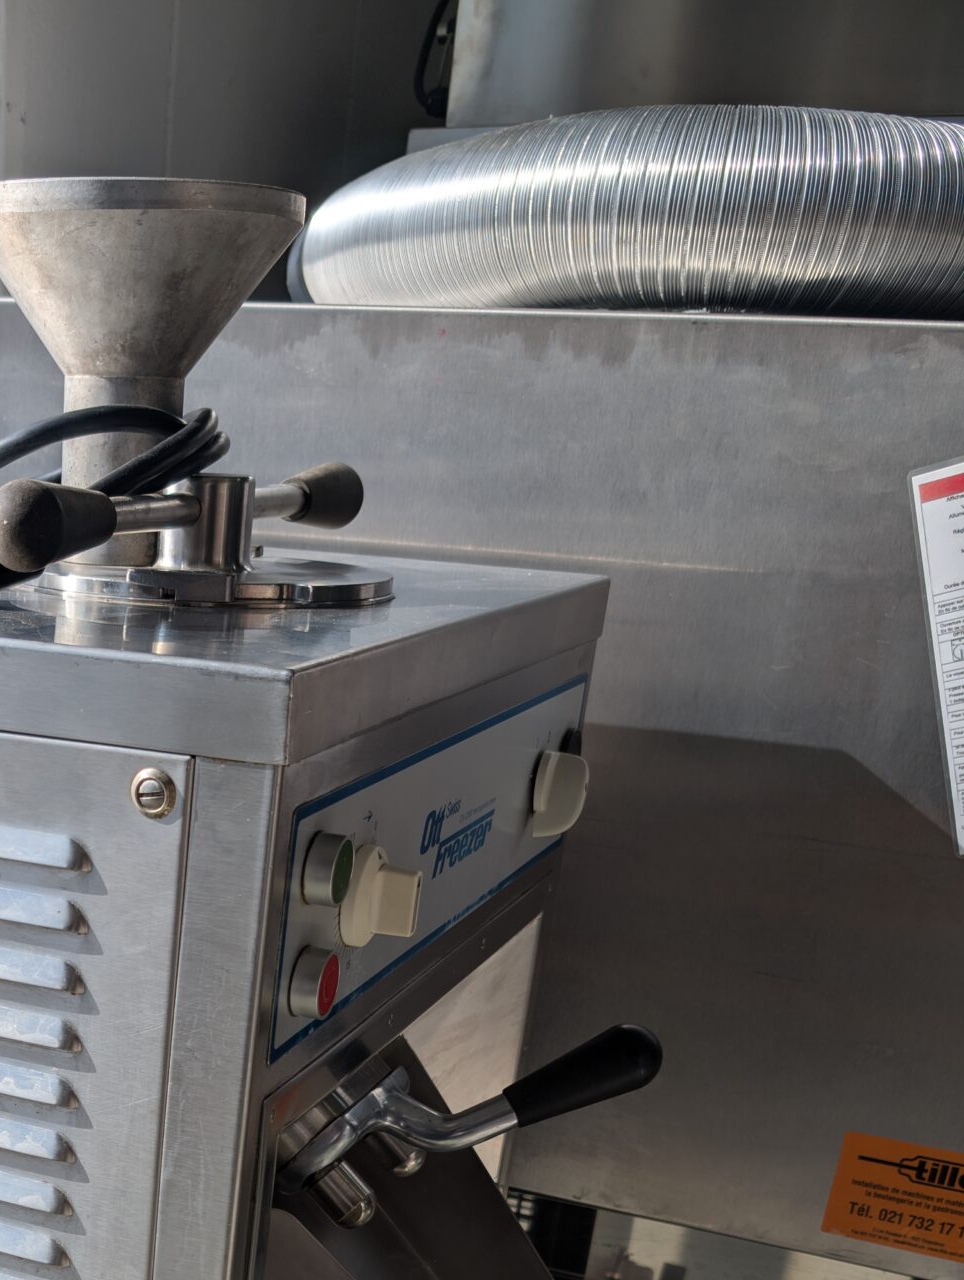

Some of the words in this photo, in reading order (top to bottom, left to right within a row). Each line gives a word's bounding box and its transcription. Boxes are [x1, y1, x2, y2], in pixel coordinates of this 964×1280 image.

[432, 808, 495, 880] Freezer
[849, 1200, 873, 1219] Tél.
[878, 1208, 904, 1225] 021
[908, 1214, 935, 1232] 732
[939, 1221, 956, 1236] 17
